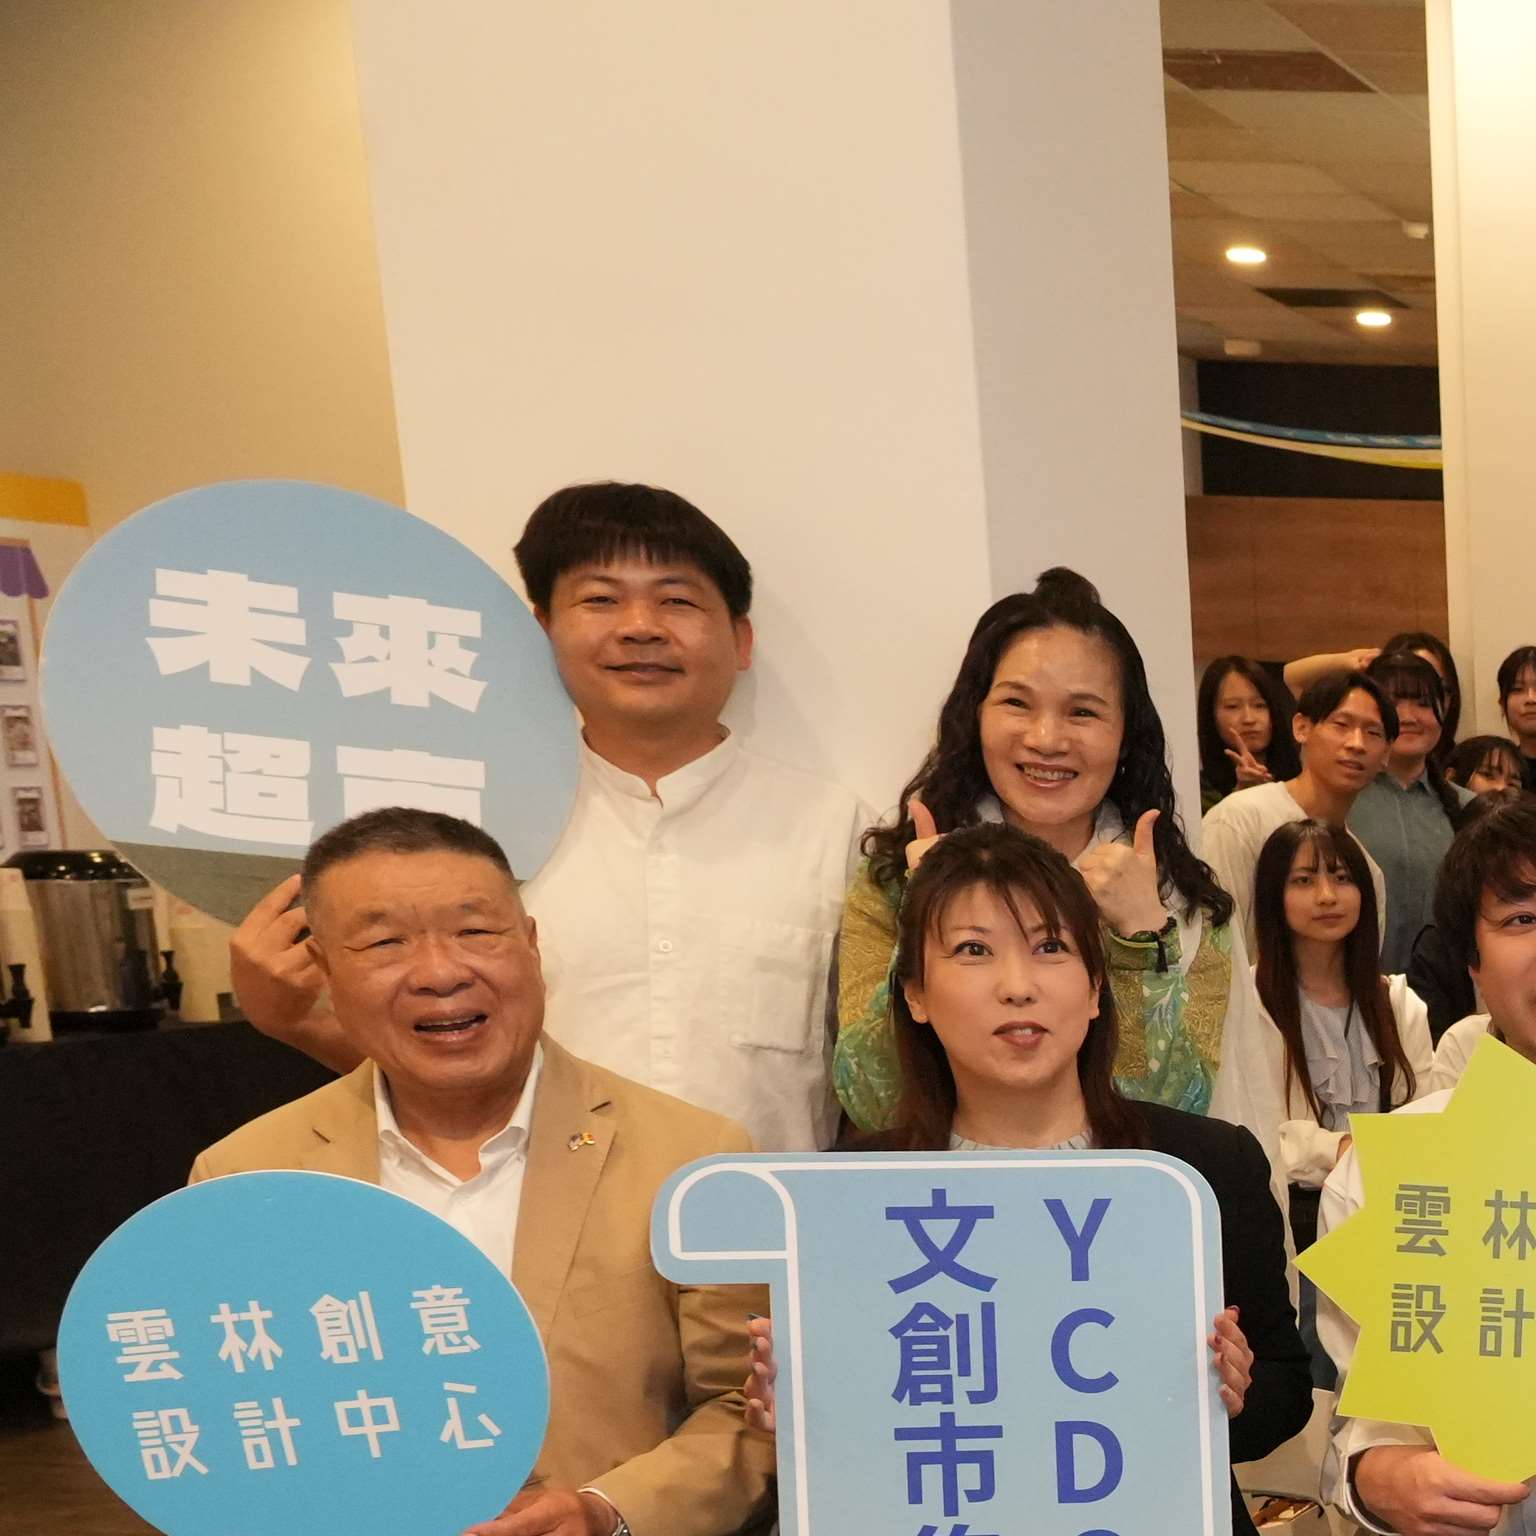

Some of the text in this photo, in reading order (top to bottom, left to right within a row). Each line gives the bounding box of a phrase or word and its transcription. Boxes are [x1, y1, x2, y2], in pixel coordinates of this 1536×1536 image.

[145, 567, 488, 713] 未來
[105, 1284, 481, 1383] 雲林創意
[132, 1381, 502, 1480] 設計中心
